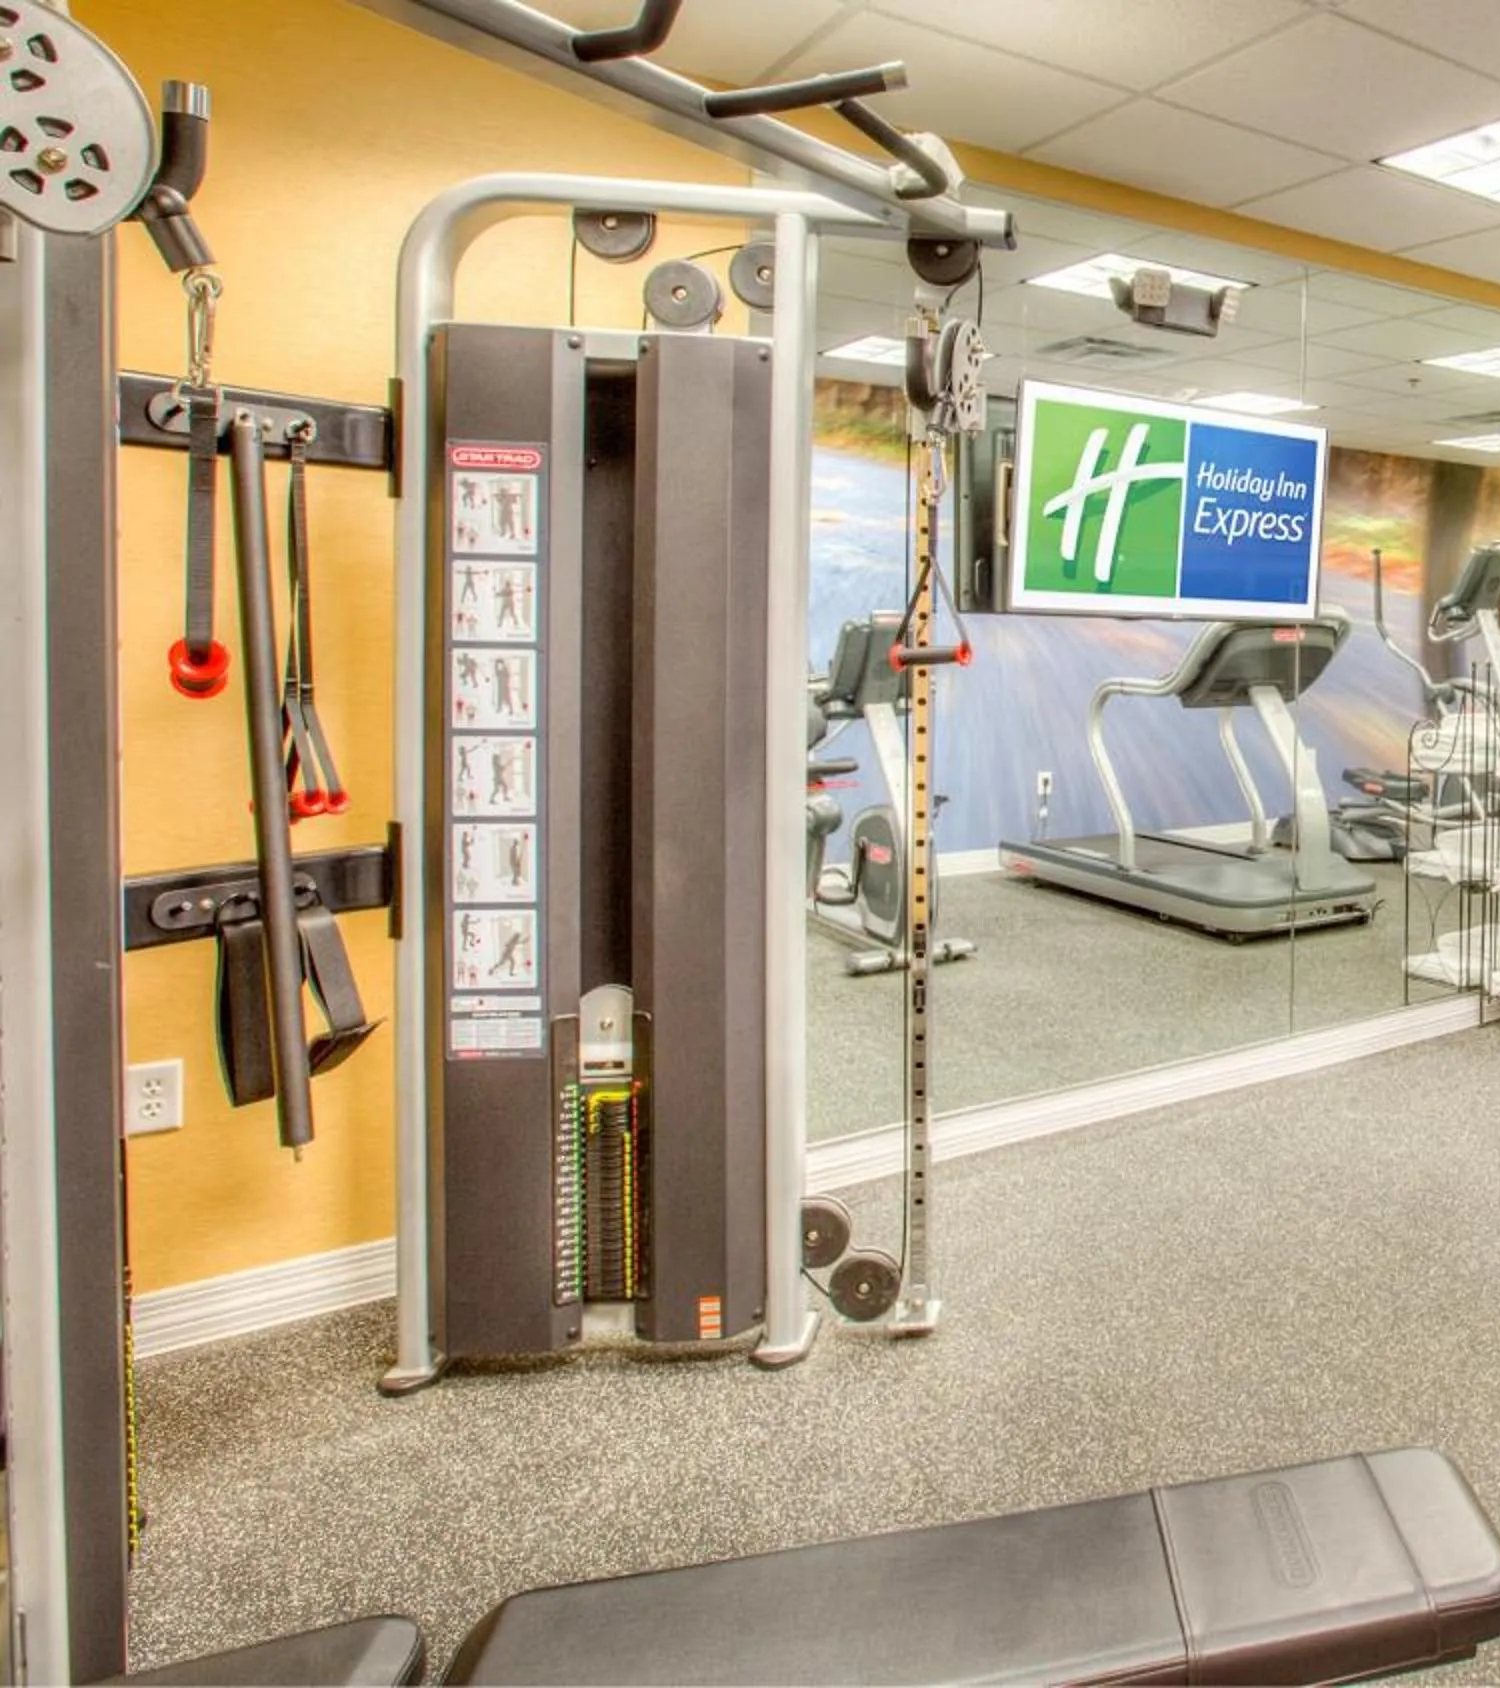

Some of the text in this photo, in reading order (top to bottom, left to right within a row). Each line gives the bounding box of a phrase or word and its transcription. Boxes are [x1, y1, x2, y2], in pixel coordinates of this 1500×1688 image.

[1196, 460, 1307, 502] Holiday Inn
[1193, 496, 1305, 545] Express
